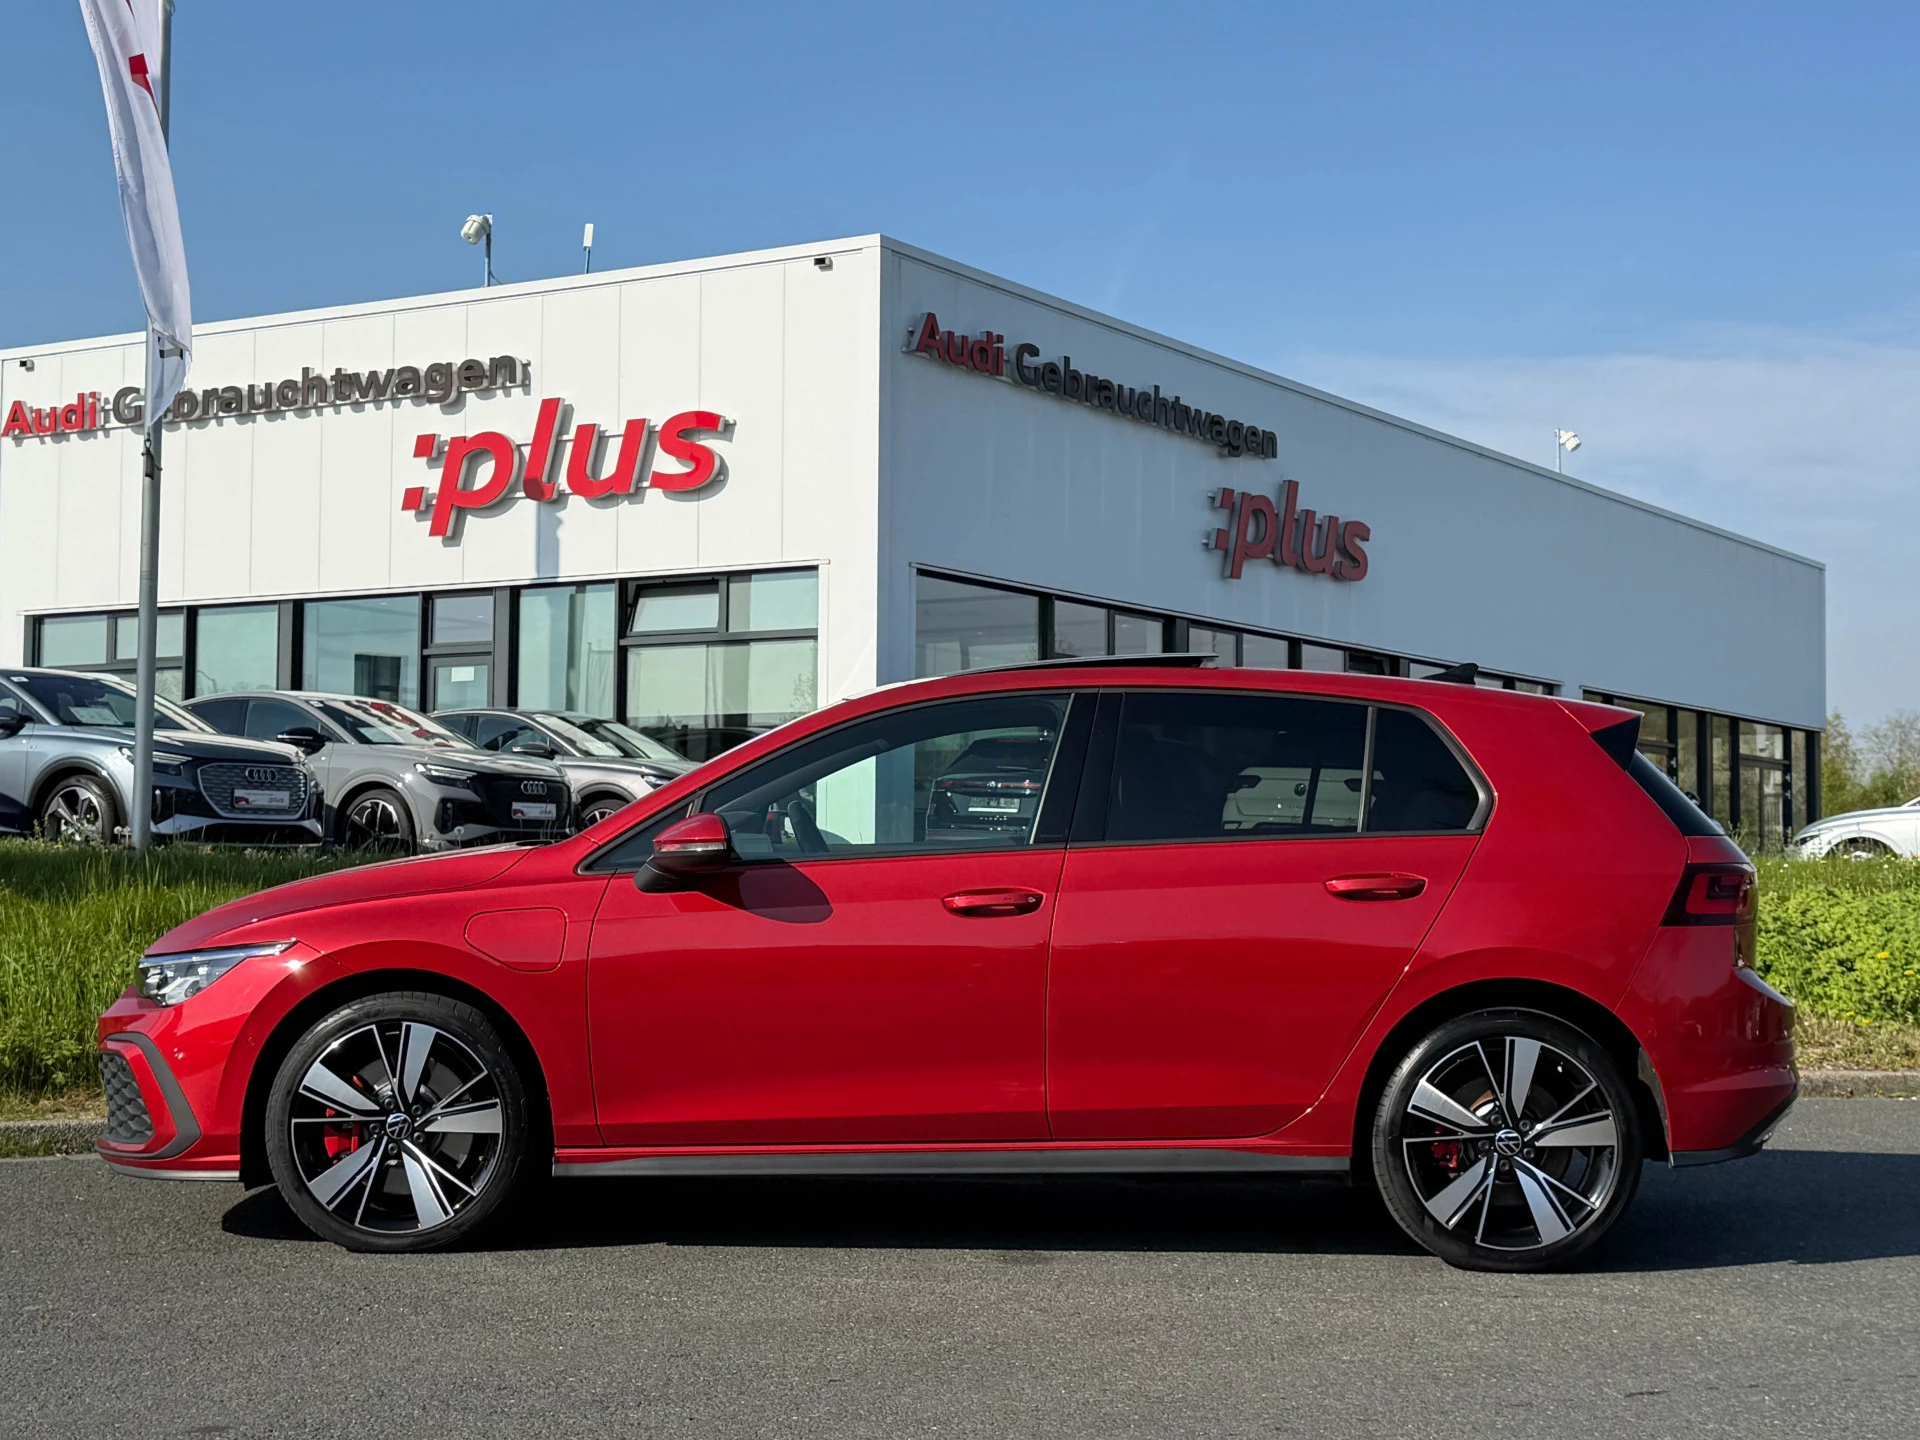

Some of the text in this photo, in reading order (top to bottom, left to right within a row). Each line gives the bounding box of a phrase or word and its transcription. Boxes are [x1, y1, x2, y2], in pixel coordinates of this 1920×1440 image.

[1, 354, 518, 437] Audi Gbrauchtwagen
[914, 312, 1278, 459] Audi Gebrauchtwagen
